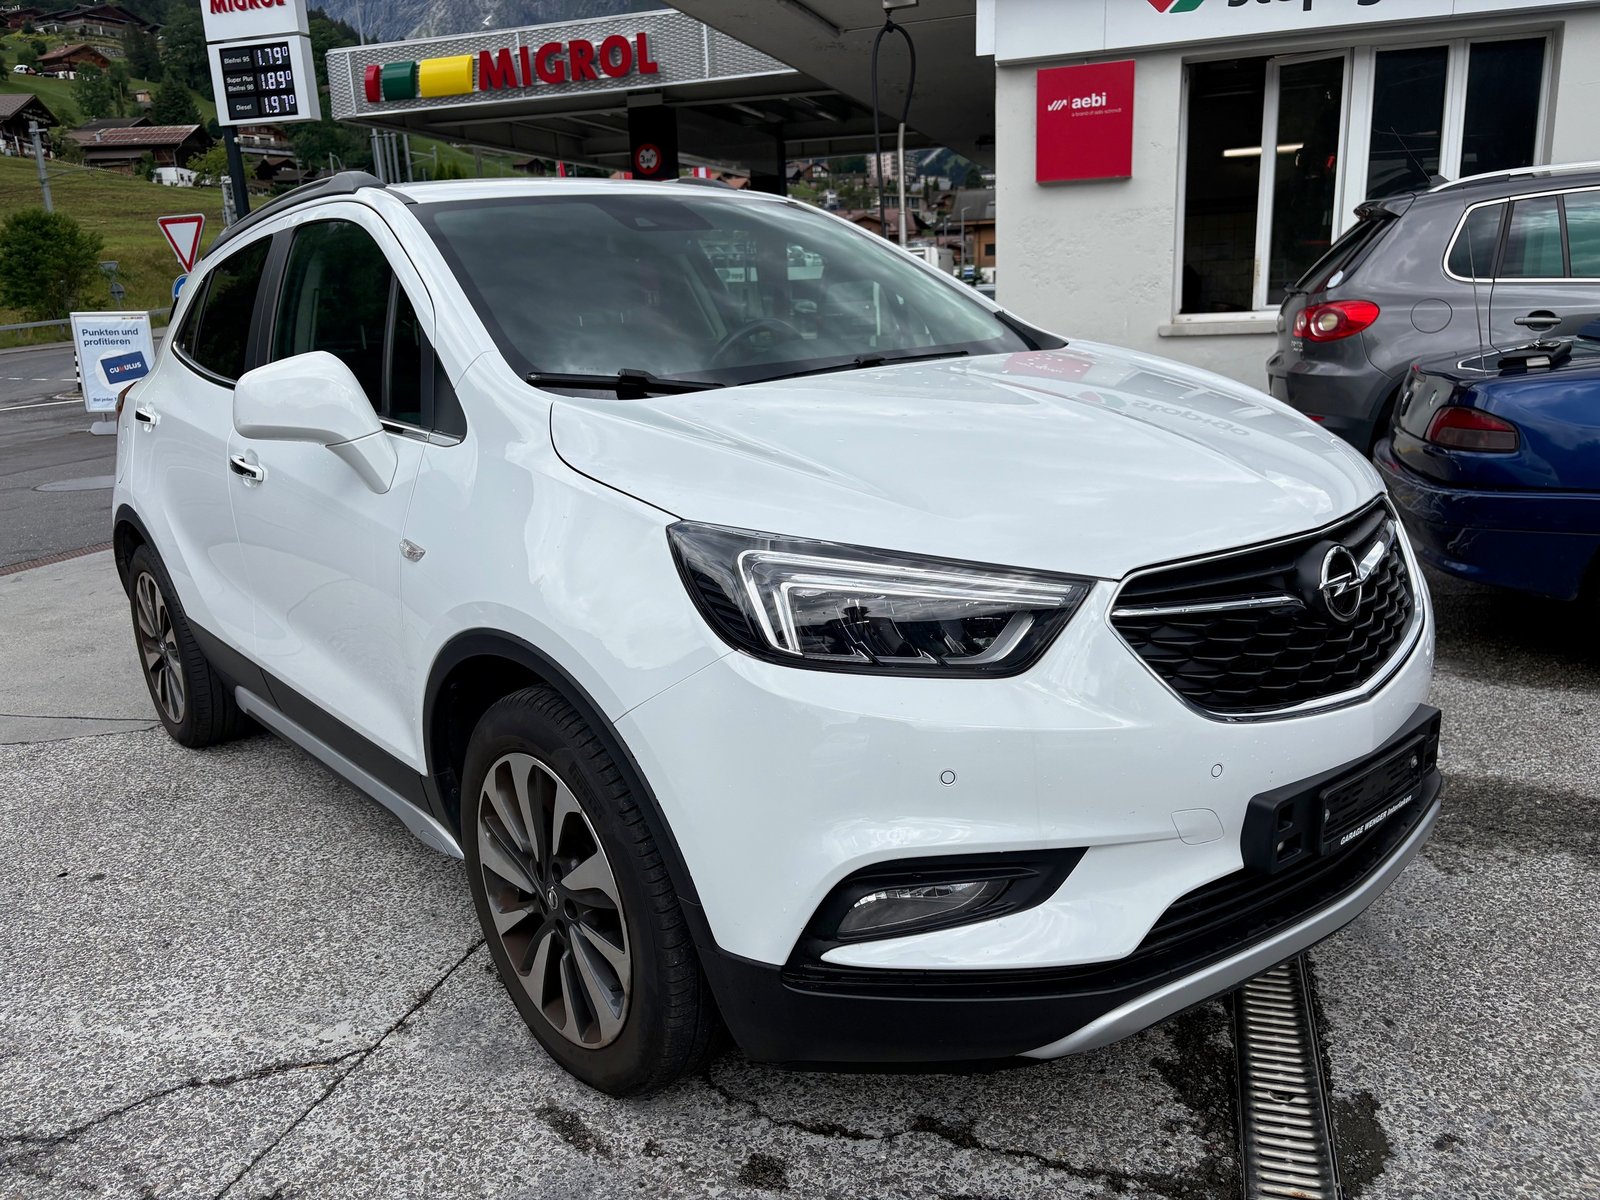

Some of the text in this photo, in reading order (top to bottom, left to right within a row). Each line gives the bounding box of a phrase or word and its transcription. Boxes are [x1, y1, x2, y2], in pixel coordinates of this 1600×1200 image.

[478, 32, 658, 91] MIGROL
[1072, 92, 1106, 109] aebi
[84, 338, 130, 347] profitieren
[1341, 825, 1364, 845] GARAGE
[1365, 810, 1387, 830] WENGER
